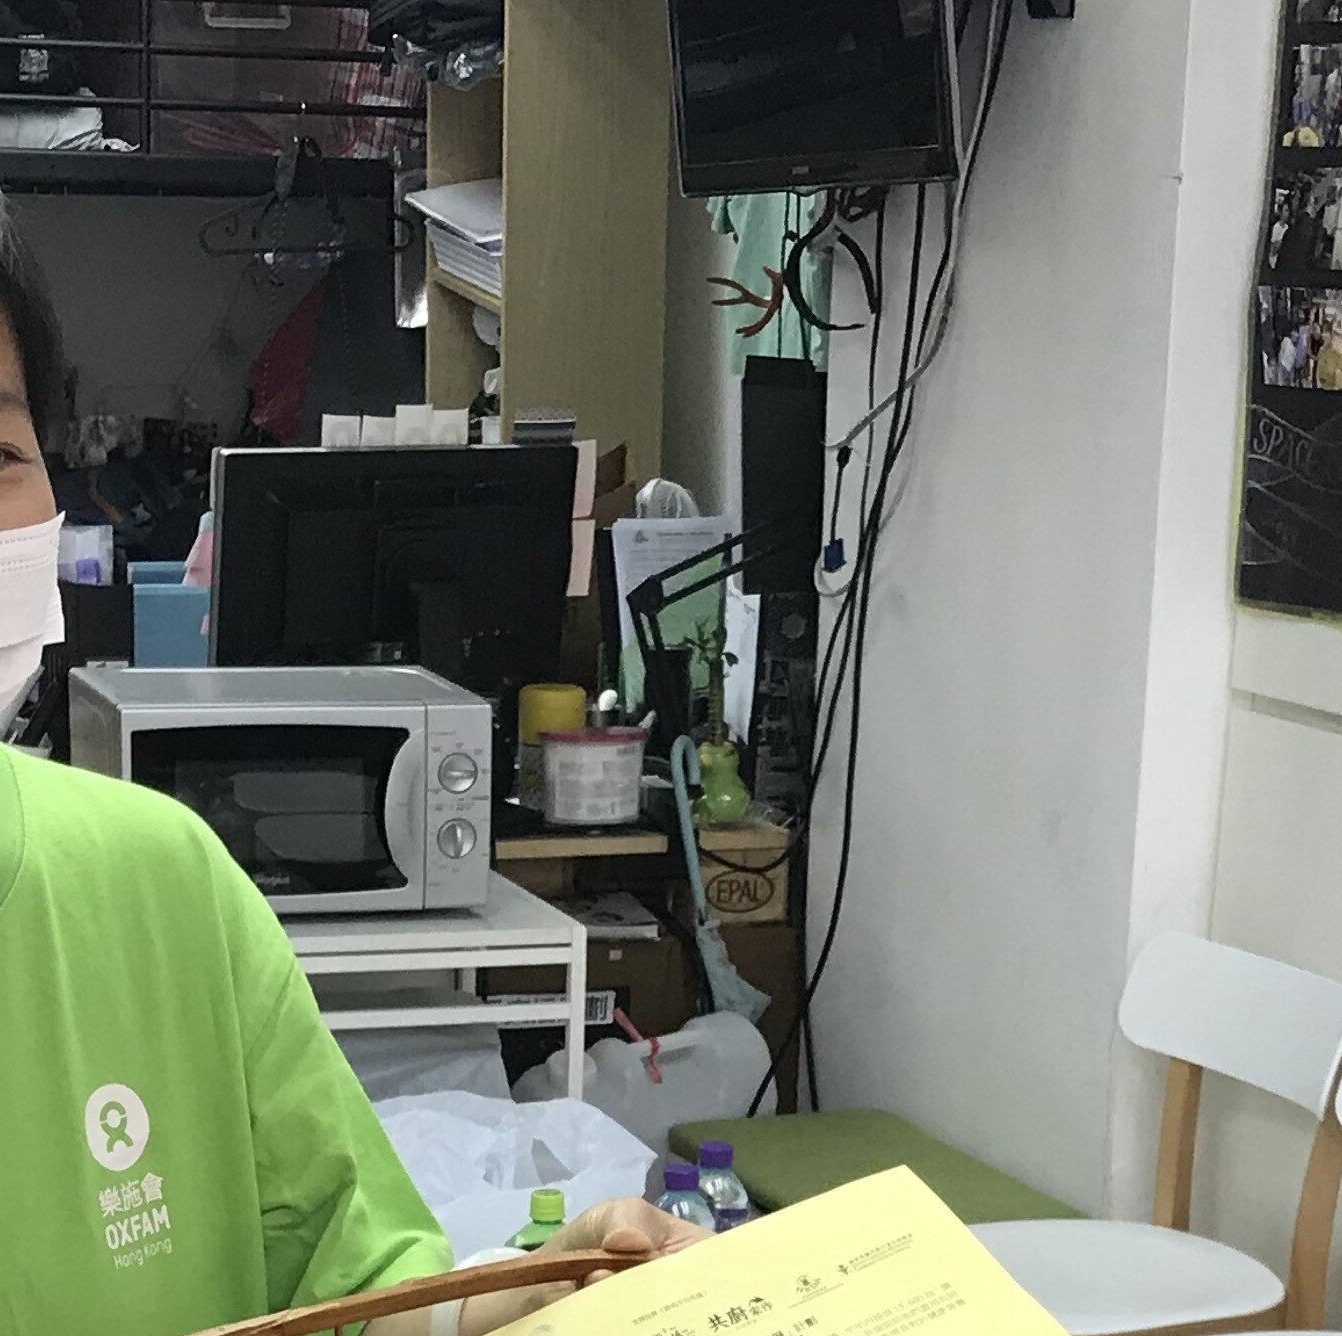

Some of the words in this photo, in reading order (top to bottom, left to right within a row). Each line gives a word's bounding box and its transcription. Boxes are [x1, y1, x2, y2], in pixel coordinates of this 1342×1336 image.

[98, 1172, 164, 1218] 樂施會
[104, 1204, 171, 1250] OXFAM
[113, 1247, 144, 1270] Hong
[144, 1237, 173, 1259] Kong
